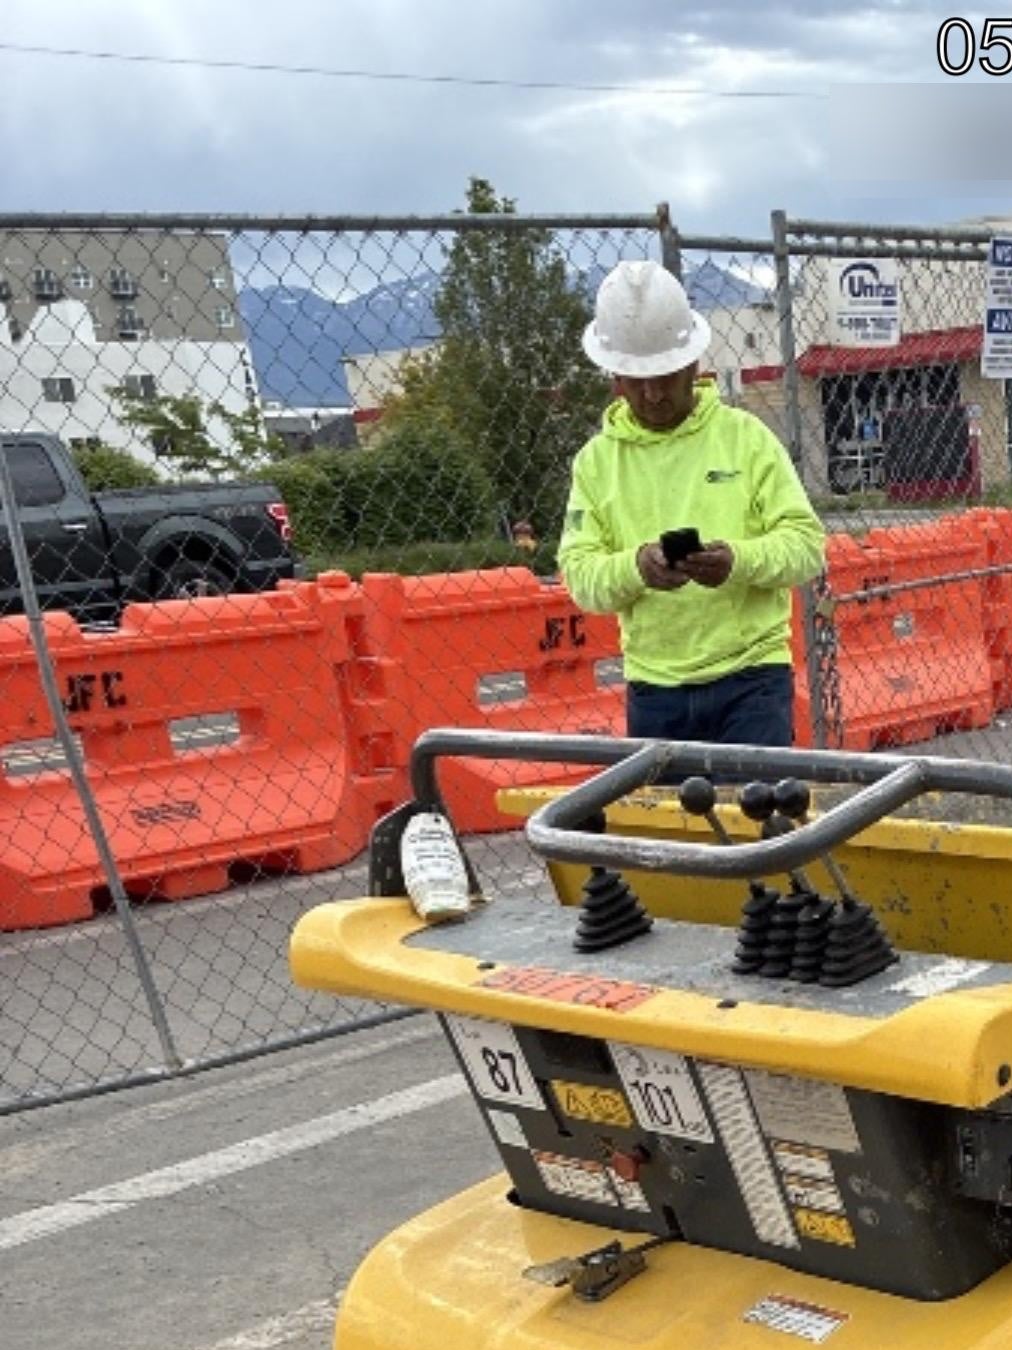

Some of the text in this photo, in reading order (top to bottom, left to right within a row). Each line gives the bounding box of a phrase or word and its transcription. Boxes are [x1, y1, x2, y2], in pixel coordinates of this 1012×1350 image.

[62, 671, 126, 712] JFC
[481, 1046, 523, 1096] 87
[628, 1080, 687, 1131] 101
